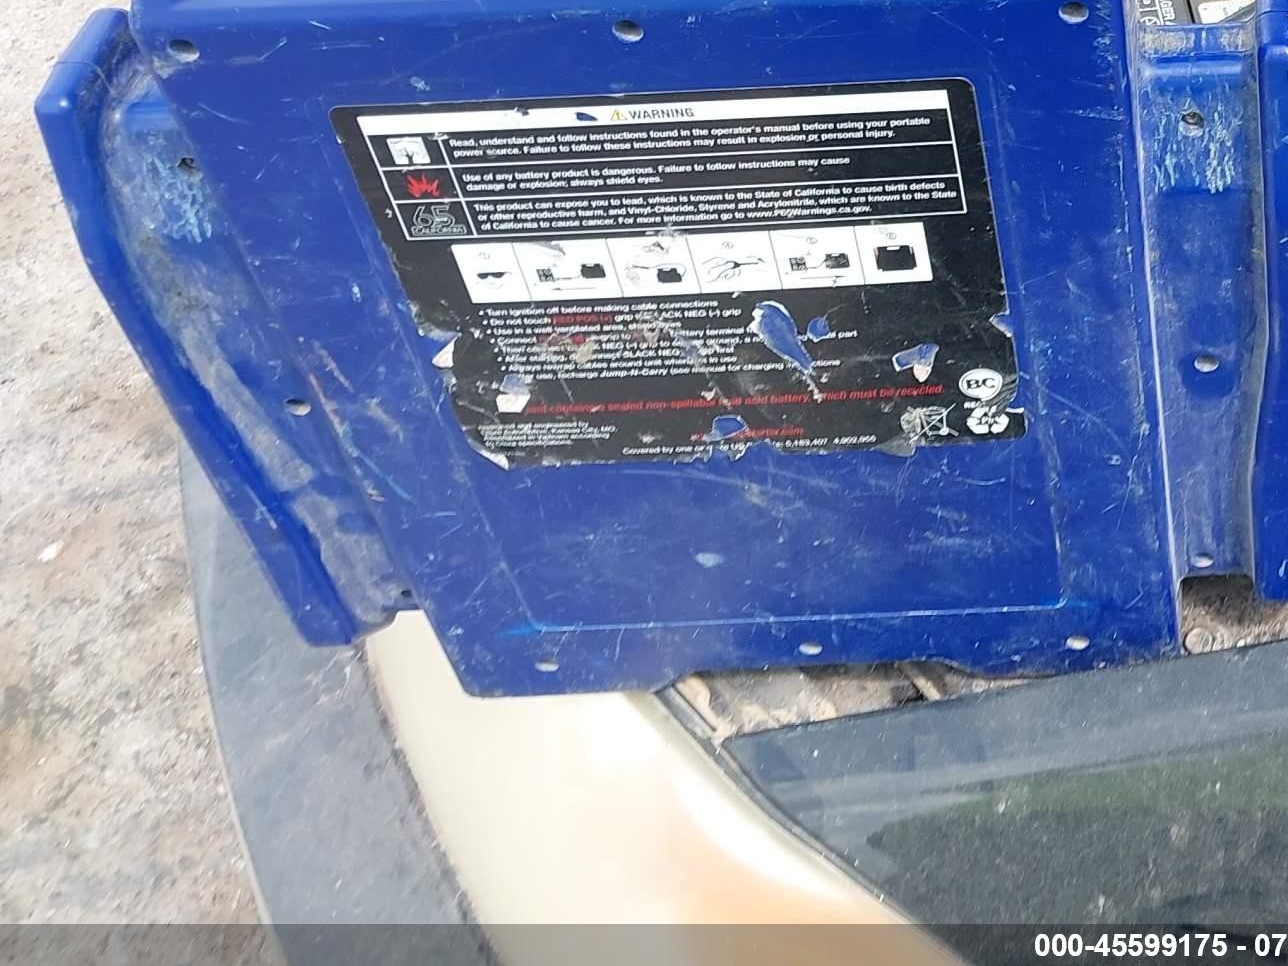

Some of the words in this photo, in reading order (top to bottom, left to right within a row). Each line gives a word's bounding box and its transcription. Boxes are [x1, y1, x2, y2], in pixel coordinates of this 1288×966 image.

[629, 108, 694, 119] WARNING
[448, 138, 478, 149] Read,
[477, 135, 534, 145] understand
[535, 134, 556, 143] and
[556, 133, 588, 142] follow
[588, 130, 647, 140] instructions
[648, 128, 678, 137] found
[679, 128, 691, 136] in
[691, 127, 709, 135] the
[710, 125, 762, 136] operator's
[762, 123, 800, 132] manual
[801, 121, 835, 130] before
[836, 120, 864, 131] using
[865, 121, 888, 129] your
[889, 117, 931, 128] portable
[452, 150, 485, 158] power
[522, 144, 558, 153] Failure
[570, 142, 602, 151] follow
[602, 141, 631, 149] these
[632, 138, 691, 148] instructions
[693, 139, 715, 147] may
[716, 136, 745, 144] result
[746, 135, 757, 143] in
[759, 133, 806, 144] explosion
[820, 130, 863, 141] personal
[864, 129, 896, 139] injury.
[514, 170, 551, 180] battery
[551, 169, 589, 179] product
[600, 165, 657, 176] dangerous.
[657, 164, 692, 172] Failure
[705, 162, 736, 170] follow
[737, 159, 795, 168] instructions
[797, 159, 820, 167] may
[465, 183, 506, 192] damage
[569, 178, 605, 187] always
[605, 176, 636, 184] shield
[473, 204, 495, 212] This
[495, 202, 534, 212] product
[553, 201, 590, 209] expose
[621, 196, 647, 206] lead,
[646, 195, 677, 203] which
[688, 193, 723, 201] known
[735, 191, 752, 199] the
[753, 190, 780, 198] State
[793, 187, 840, 196] California
[908, 182, 945, 190] defects
[488, 212, 515, 220] other
[515, 209, 577, 221] reproductive
[576, 208, 607, 218] harm,
[626, 204, 697, 215] Vinyl-Chloride,
[697, 202, 736, 212] Styrene
[756, 198, 817, 209] Acrylonitrile,
[818, 196, 848, 204] which
[867, 194, 900, 202] known
[913, 192, 929, 200] the
[931, 191, 957, 199] State
[412, 205, 456, 227] 65
[491, 221, 538, 230] California
[617, 216, 635, 224] For
[662, 212, 718, 221] information
[485, 308, 508, 316] Turn
[508, 307, 546, 316] ignition
[592, 303, 630, 312] making
[657, 300, 719, 308] connections
[522, 316, 552, 324] touch
[720, 308, 742, 317] grip
[704, 327, 745, 335] terminal
[837, 330, 858, 338] part
[741, 362, 785, 371] charging
[848, 388, 879, 398] must
[878, 387, 895, 396] be
